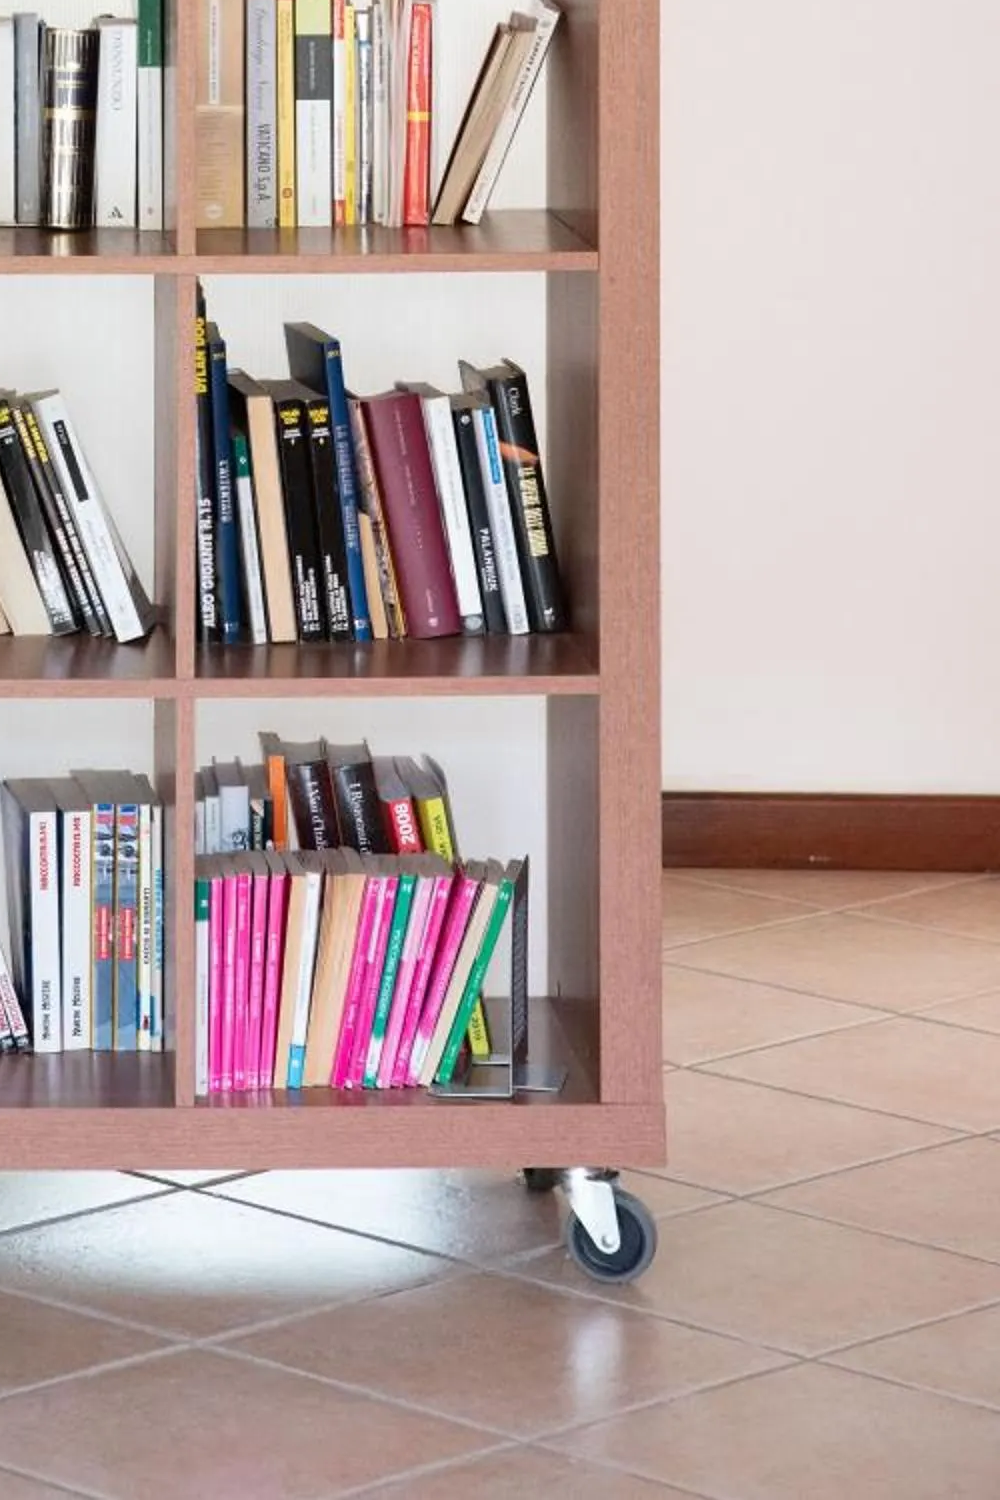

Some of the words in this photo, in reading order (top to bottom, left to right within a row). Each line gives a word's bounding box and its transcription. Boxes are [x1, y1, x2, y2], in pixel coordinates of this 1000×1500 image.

[257, 124, 271, 173] VATICANO
[194, 318, 205, 351] DOG
[195, 357, 207, 393] DYLAN
[201, 594, 216, 627] ALBO
[394, 803, 415, 844] 2008
